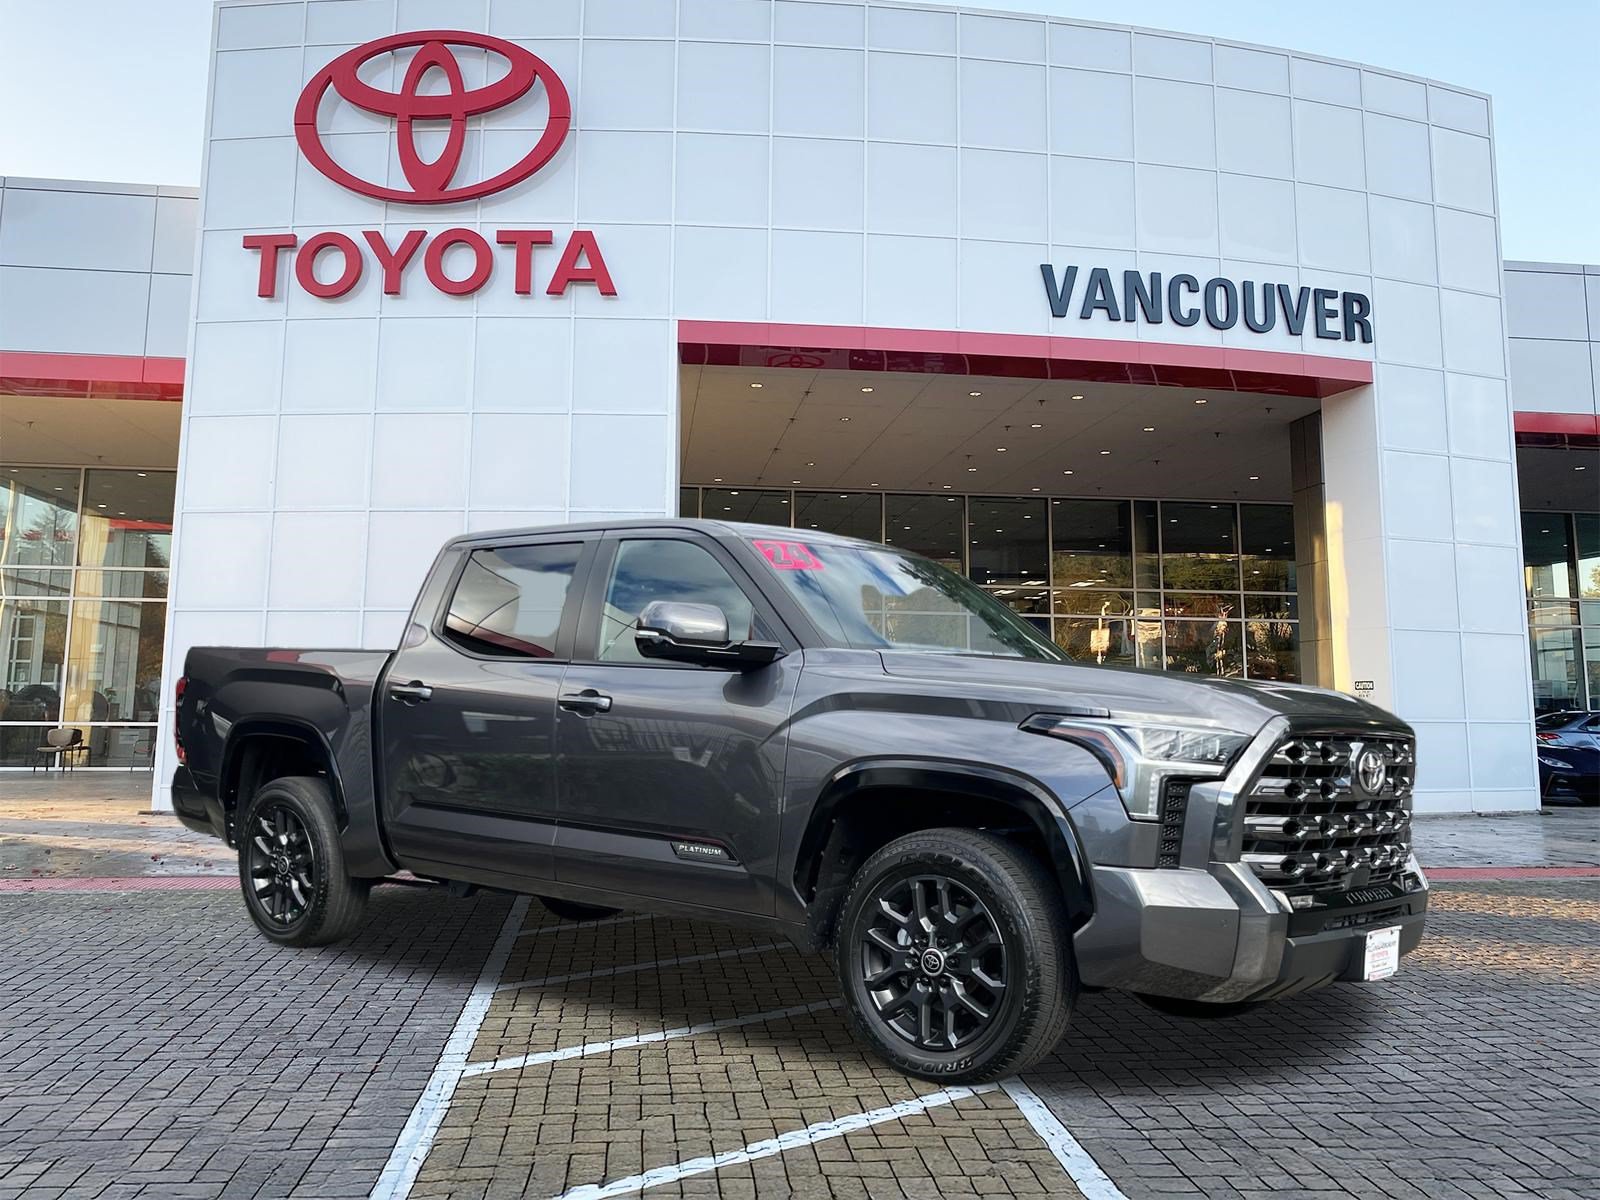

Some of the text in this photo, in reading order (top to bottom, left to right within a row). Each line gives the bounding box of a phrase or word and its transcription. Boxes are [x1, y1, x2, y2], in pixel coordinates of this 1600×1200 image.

[243, 228, 617, 298] TOYOTA
[1040, 264, 1373, 343] VANCOUVER
[761, 543, 814, 567] 24
[679, 844, 722, 856] PLATINUM
[1346, 886, 1394, 904] TUNDRA
